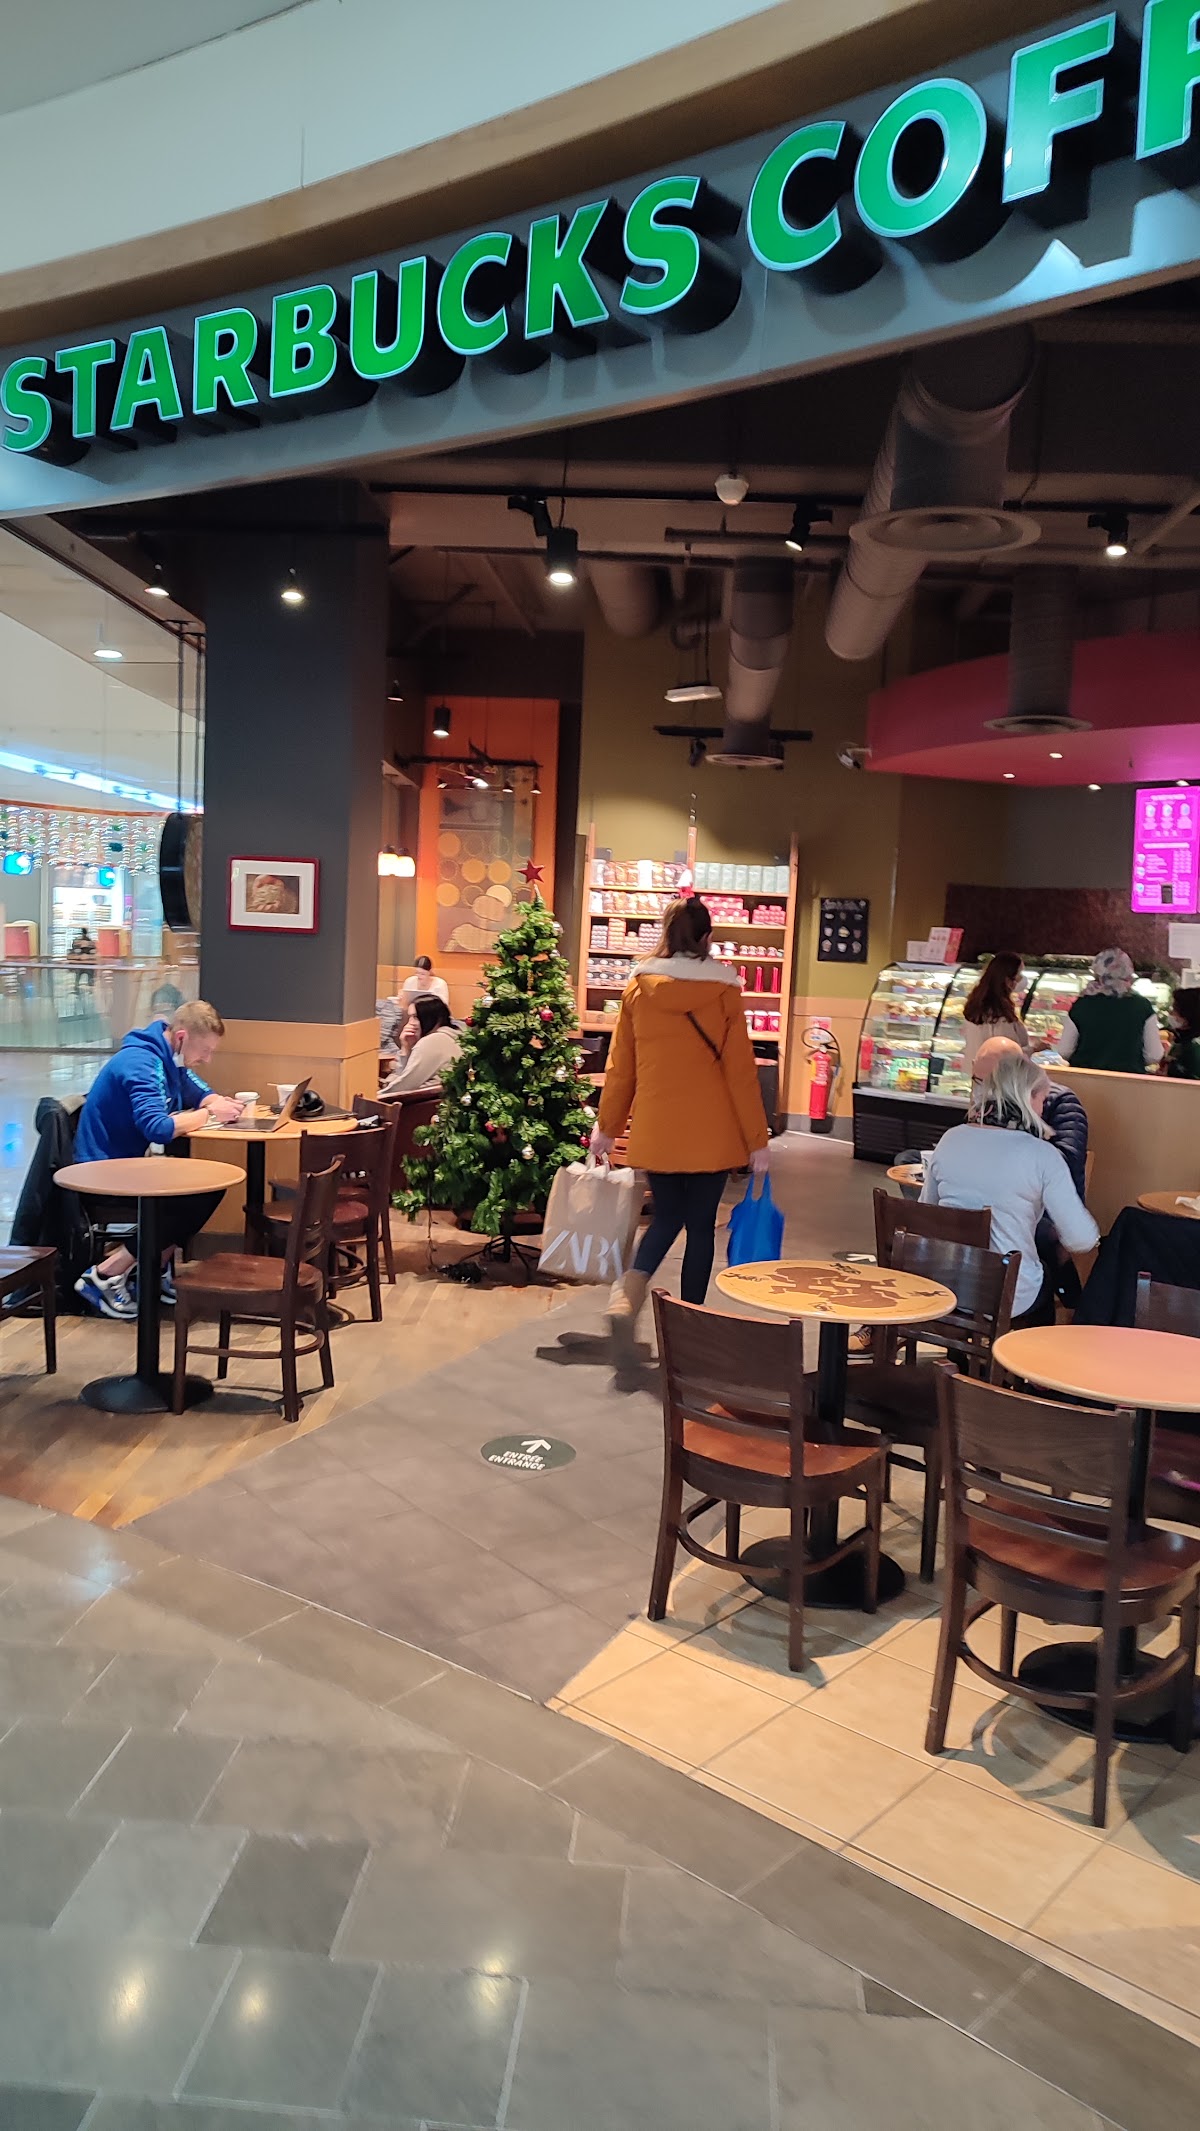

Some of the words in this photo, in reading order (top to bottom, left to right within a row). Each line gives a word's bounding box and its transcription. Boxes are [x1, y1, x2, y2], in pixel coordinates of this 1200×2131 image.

[1, 176, 701, 452] STARBUCKS
[538, 1228, 624, 1279] ZARA
[488, 1454, 545, 1470] ENTRANCE
